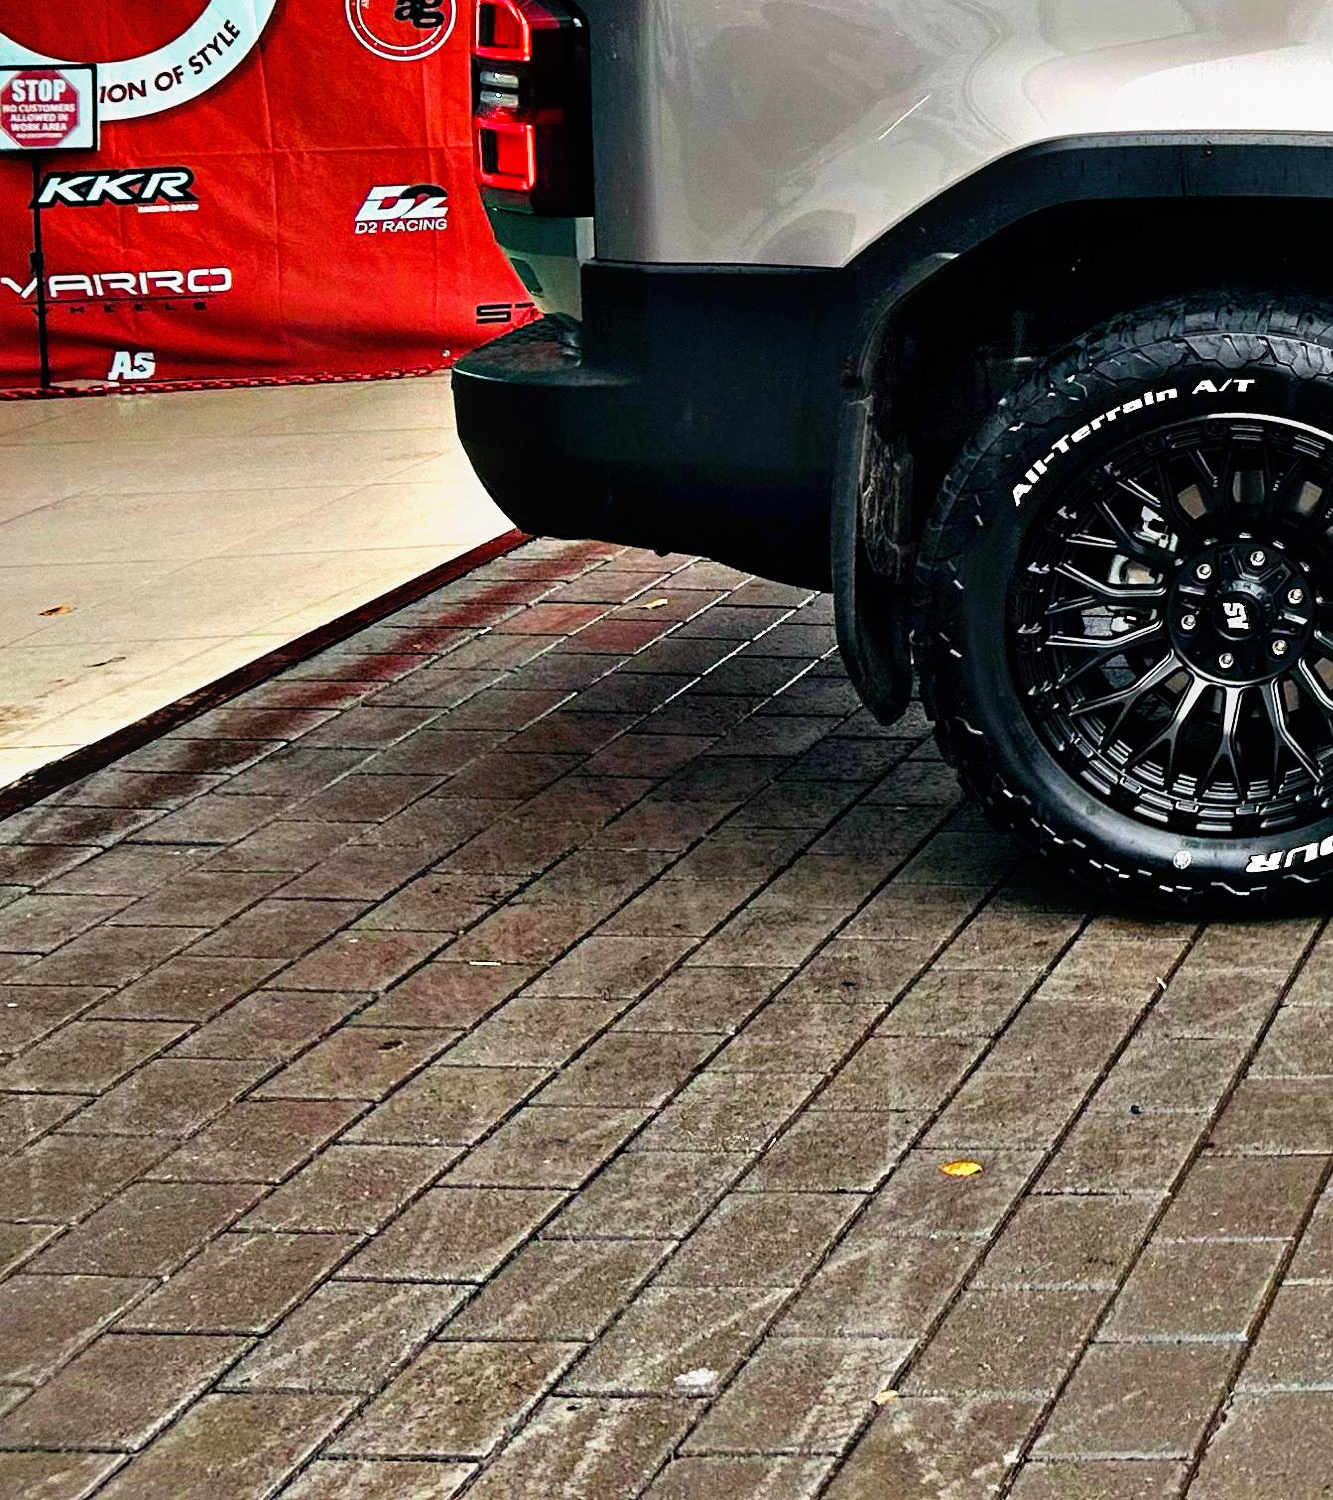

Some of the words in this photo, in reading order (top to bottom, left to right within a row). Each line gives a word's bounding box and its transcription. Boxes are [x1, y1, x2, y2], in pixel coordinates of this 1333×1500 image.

[153, 65, 186, 93] OF
[188, 18, 241, 75] STYLE
[11, 79, 66, 102] STOP
[10, 113, 56, 122] ALLOWED
[57, 113, 69, 122] IN
[18, 103, 76, 113] CUSTOMERS
[10, 123, 40, 132] WORK
[41, 122, 67, 131] AREA
[38, 172, 189, 203] KKR
[355, 221, 378, 235] D2
[381, 218, 448, 233] RACING
[107, 351, 156, 381] AS
[1012, 387, 1178, 507] All-Terrain
[1191, 379, 1256, 395] A/T
